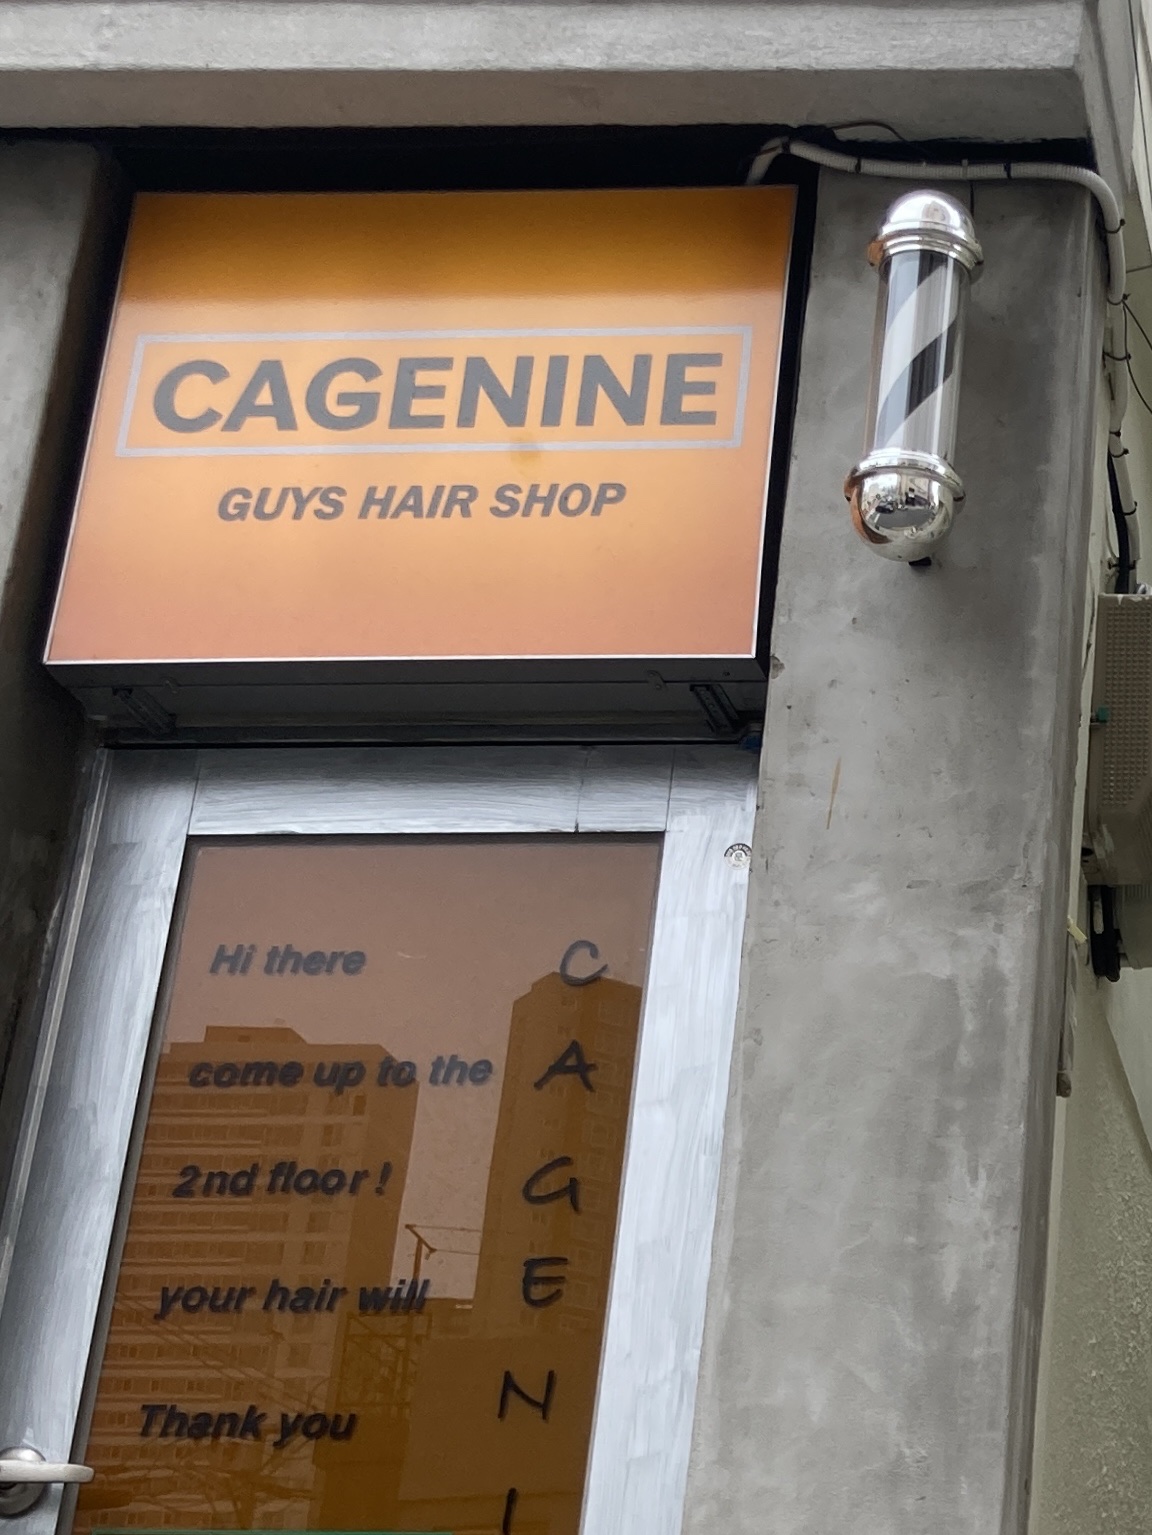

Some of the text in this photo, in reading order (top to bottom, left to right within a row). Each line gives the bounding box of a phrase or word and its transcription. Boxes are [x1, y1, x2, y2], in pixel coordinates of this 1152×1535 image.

[153, 353, 723, 434] CAGENINE
[218, 483, 627, 522] GUYS HAIR SHOP
[210, 944, 366, 976] Hi there
[189, 1054, 494, 1096] come up to the
[172, 1162, 260, 1198] 2nd
[154, 1278, 431, 1321] your hair will
[140, 1403, 358, 1448] Thank you
